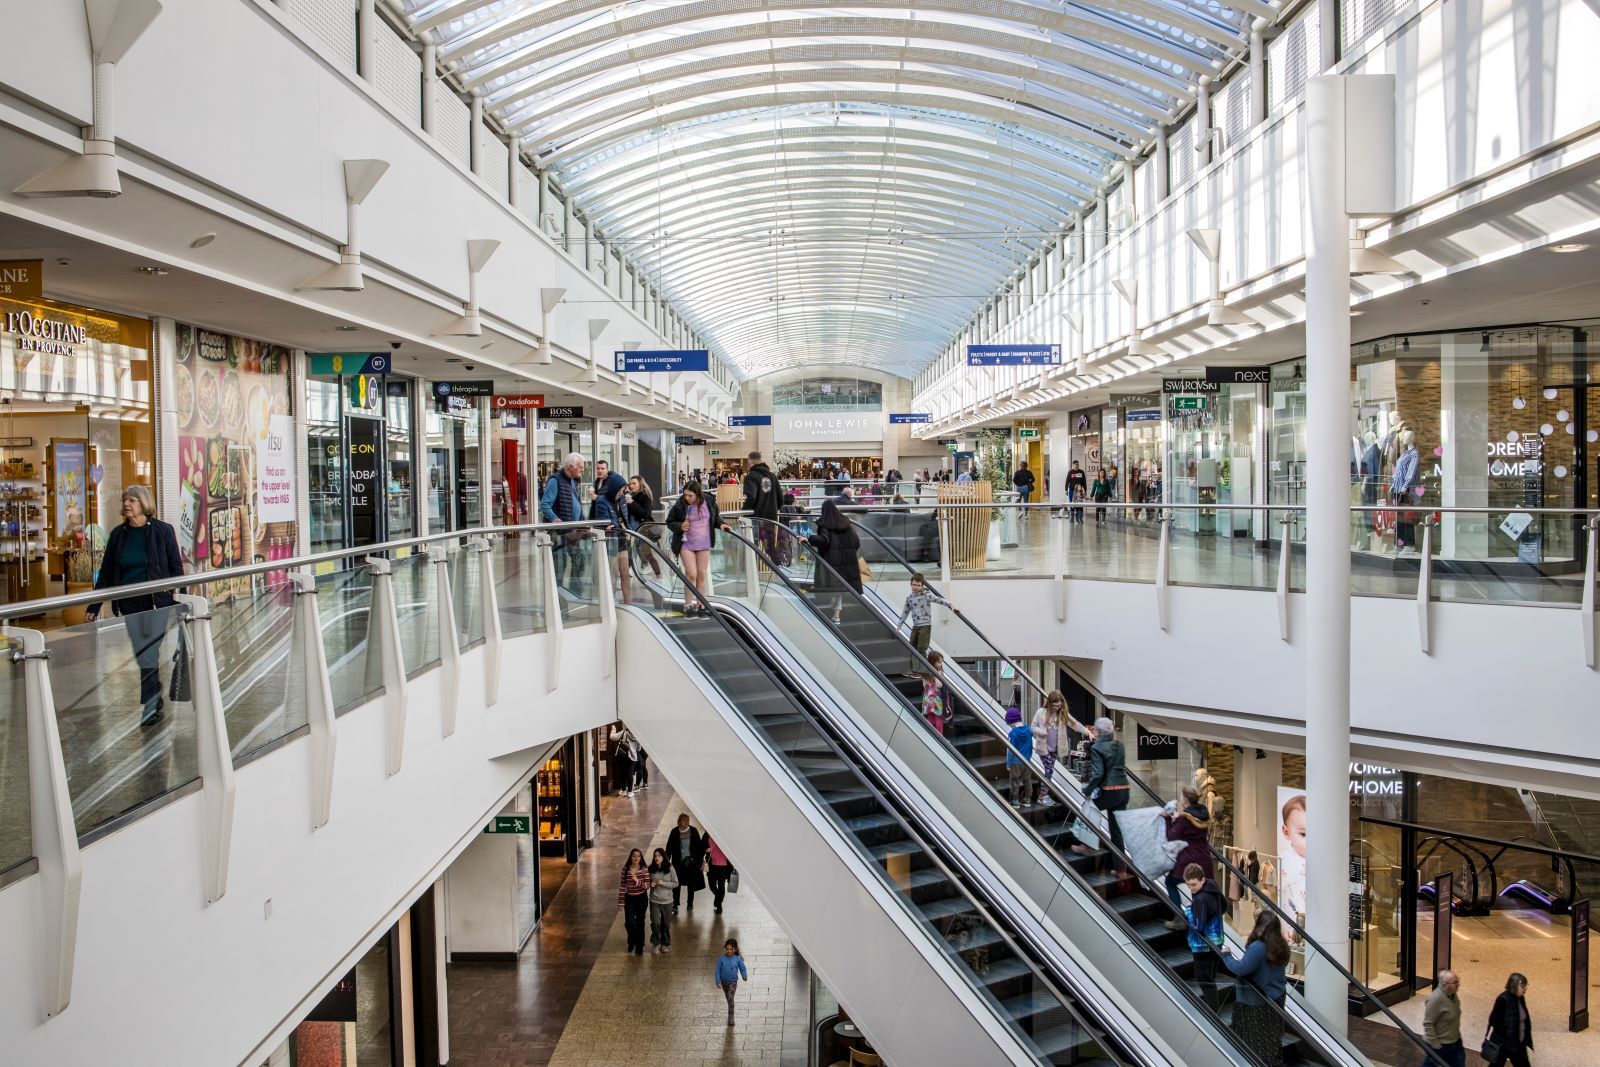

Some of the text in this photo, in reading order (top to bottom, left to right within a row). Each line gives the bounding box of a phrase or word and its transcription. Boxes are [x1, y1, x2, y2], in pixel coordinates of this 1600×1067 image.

[7, 310, 87, 345] L'OCCITANE
[22, 338, 77, 357] EN PROVENCE
[1234, 370, 1269, 382] next
[452, 384, 479, 394] thérapie
[1165, 382, 1218, 390] SWAROVSKI
[789, 420, 868, 430] JOHN LEWIS
[268, 430, 282, 450] itsu
[327, 444, 374, 454] COE ON
[269, 482, 280, 492] upper
[281, 480, 290, 490] level
